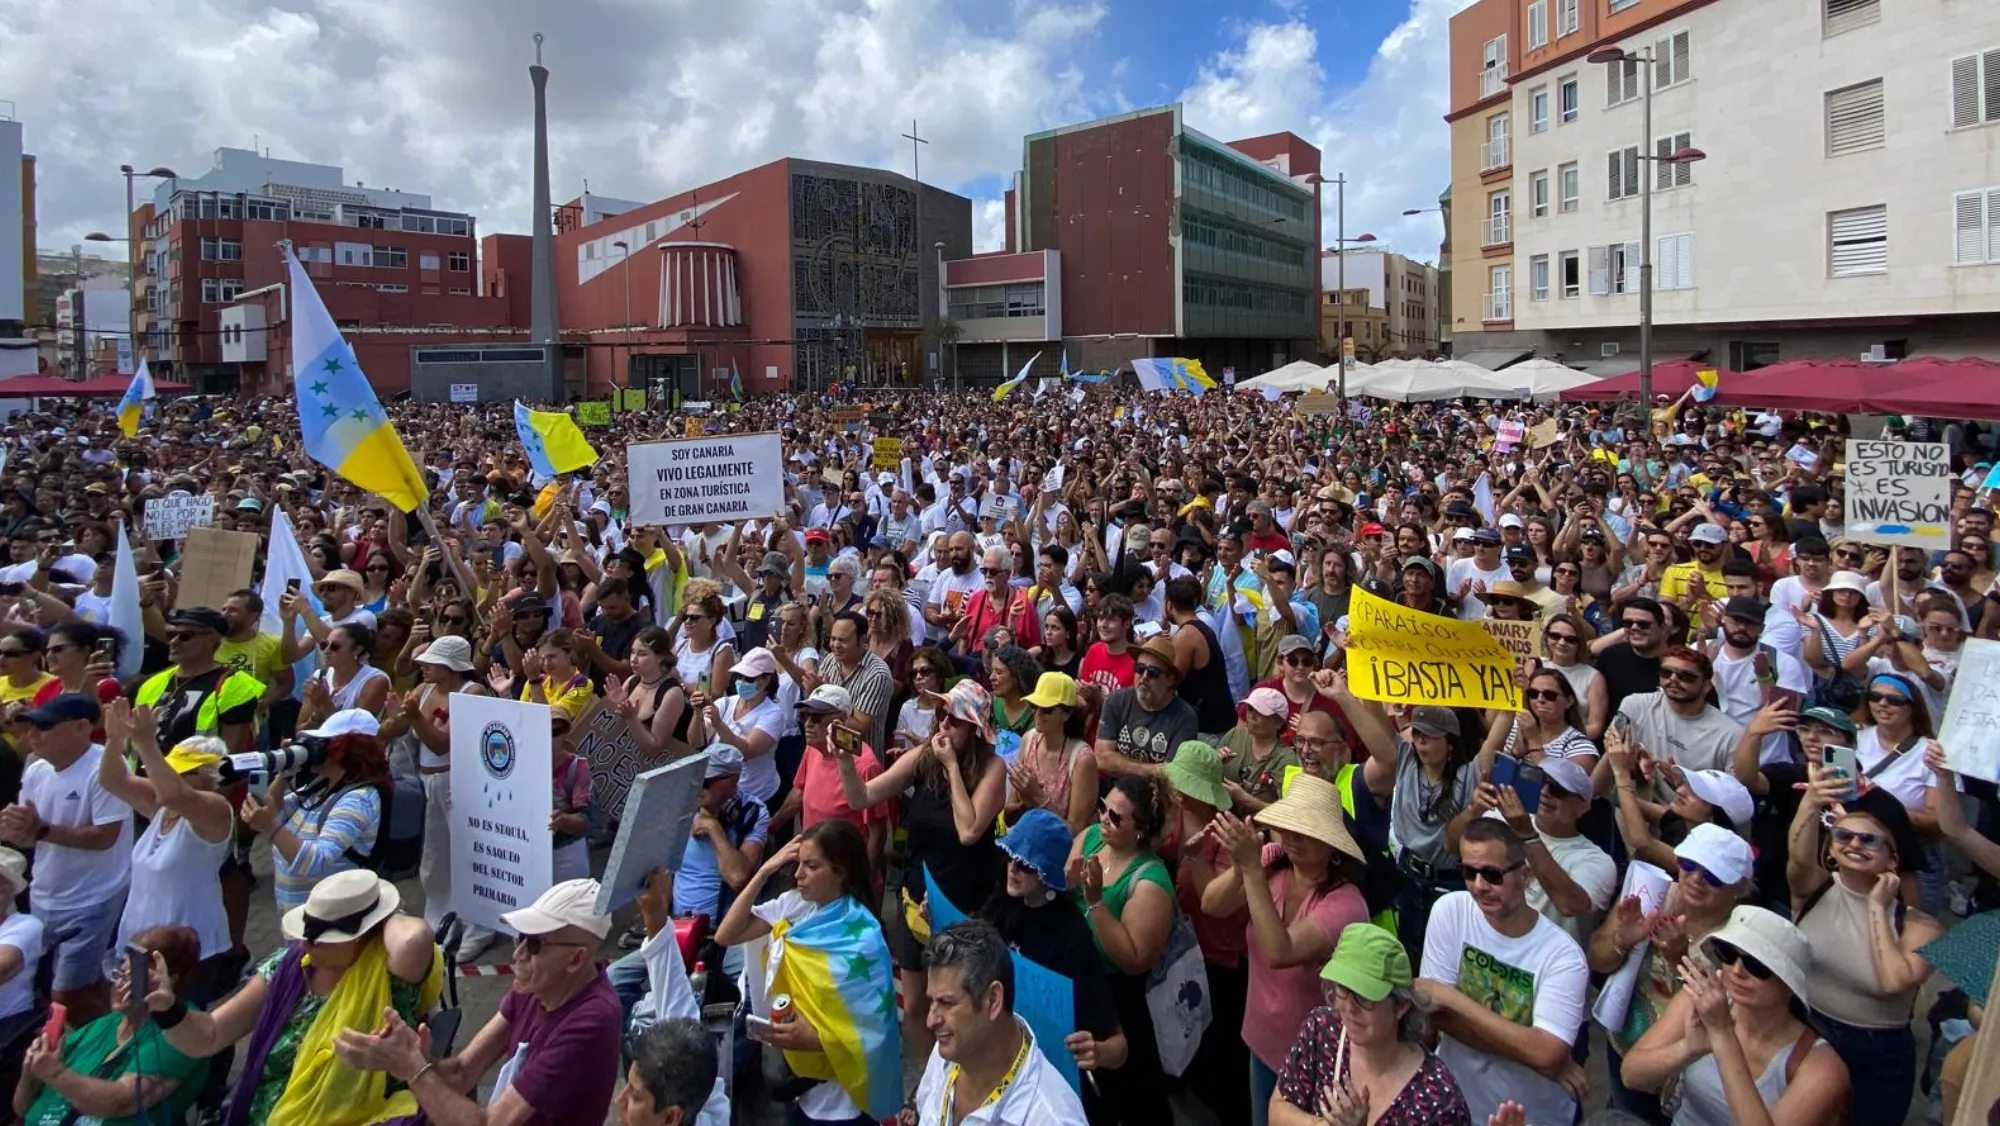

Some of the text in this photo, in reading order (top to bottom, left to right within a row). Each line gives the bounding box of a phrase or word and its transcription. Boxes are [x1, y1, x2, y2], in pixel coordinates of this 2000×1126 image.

[671, 445, 734, 461] SOY CANARIA
[1856, 442, 1944, 460] ESTO NO
[657, 461, 754, 481] VIVO LEGALMENTE
[1849, 460, 1877, 476] ES
[660, 480, 750, 500] EN ZONA TURÍSTICA
[1876, 478, 1910, 496] ES
[148, 497, 211, 510] LO QUE HAGO
[664, 500, 748, 518] DE GRAN CANARIA
[1851, 493, 1949, 523] INVASIÓN
[146, 511, 160, 520] NO
[177, 508, 196, 519] POR
[162, 520, 173, 530] ES
[1483, 622, 1532, 639] ANARY
[1499, 638, 1532, 654] ANDS
[1370, 656, 1517, 707] ¡BASTA YA!
[591, 710, 616, 732] MI
[577, 731, 616, 764] NO
[612, 755, 640, 783] ES
[467, 816, 480, 829] NO
[482, 819, 493, 832] ES
[473, 841, 520, 864] ES SAQUEO
[472, 861, 524, 887] DEL SECTOR
[472, 883, 517, 907] PRIMARIO
[1464, 946, 1532, 988] COLORS
